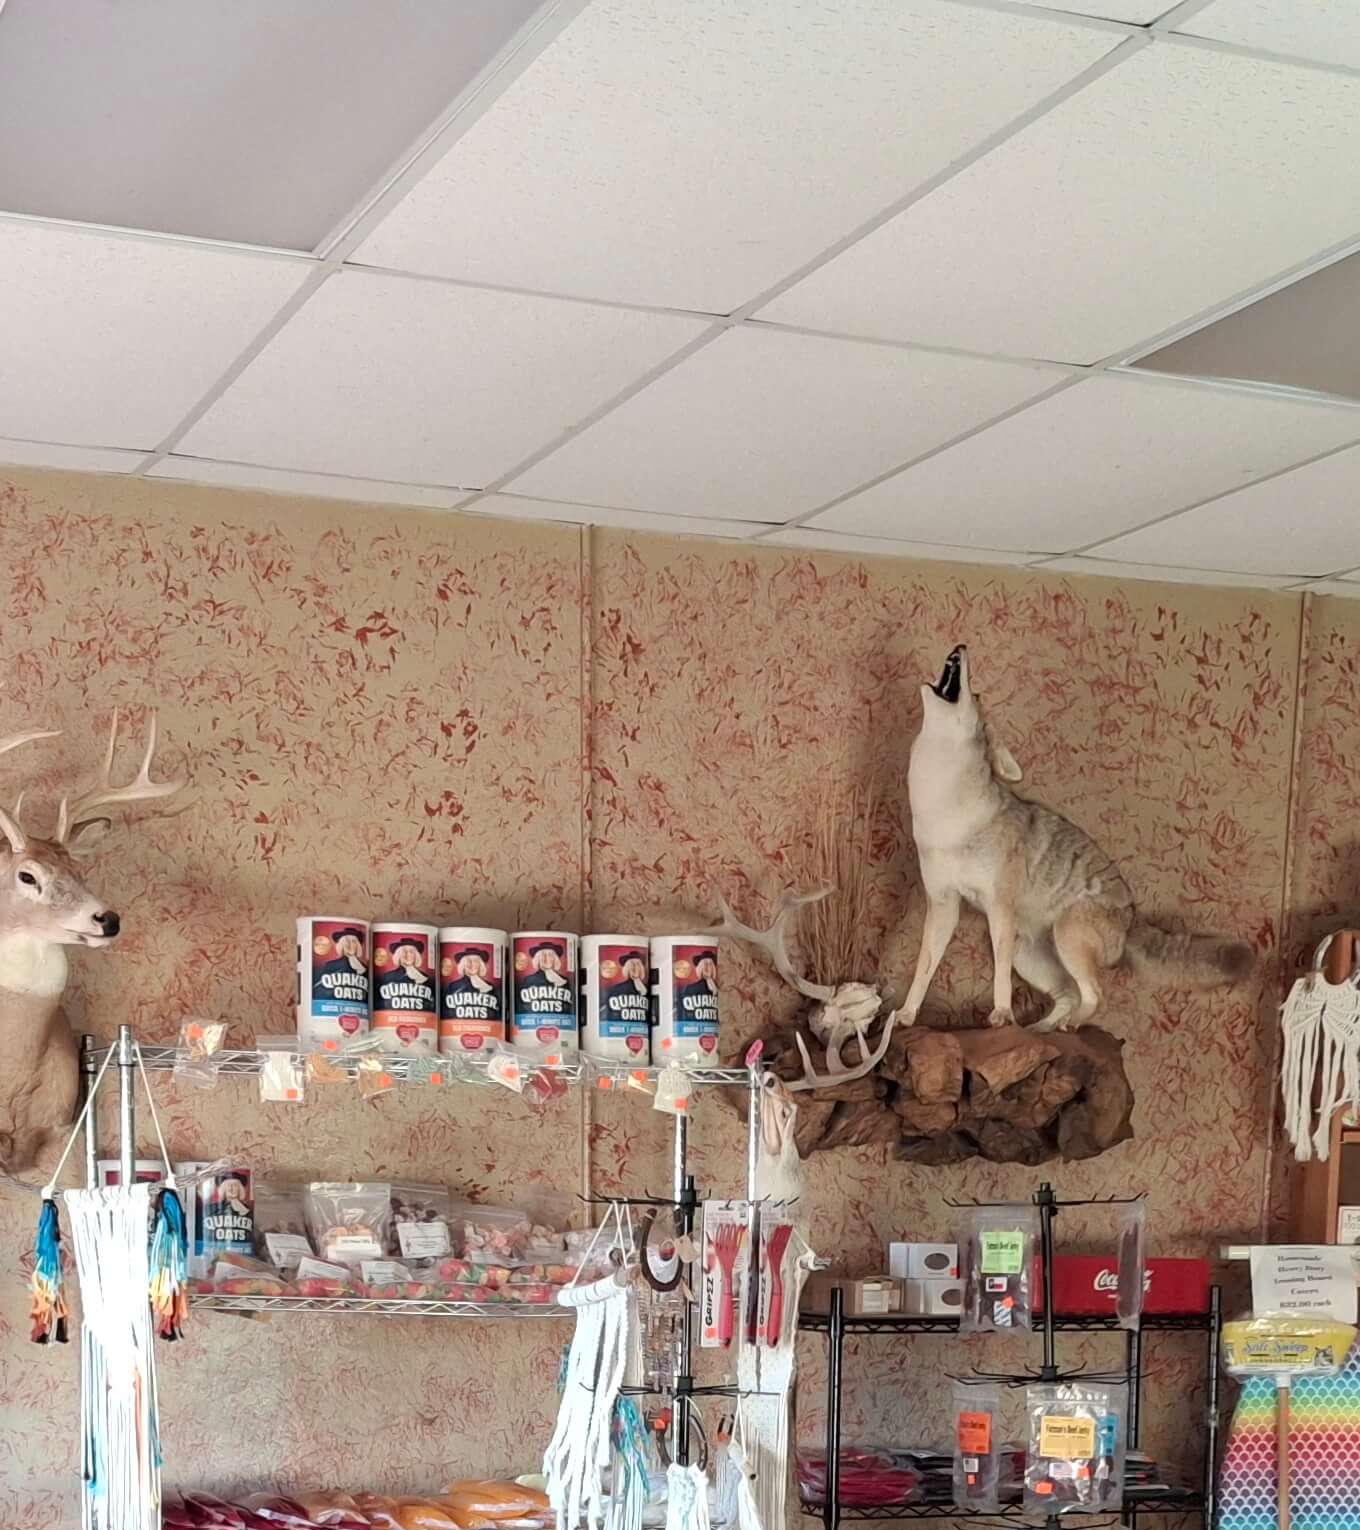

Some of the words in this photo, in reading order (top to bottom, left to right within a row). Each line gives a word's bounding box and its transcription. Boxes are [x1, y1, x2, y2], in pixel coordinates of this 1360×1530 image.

[334, 986, 363, 1000] OATS
[380, 982, 432, 1001] QUAKER
[520, 986, 572, 1002] QUAKER
[391, 997, 423, 1010] OATS
[446, 991, 498, 1009] QUAKER
[531, 1000, 563, 1012] OATS
[609, 995, 649, 1010] QUAKE
[455, 1006, 488, 1019] OATS
[204, 1215, 253, 1232] QUAKER
[216, 1229, 246, 1241] OATS
